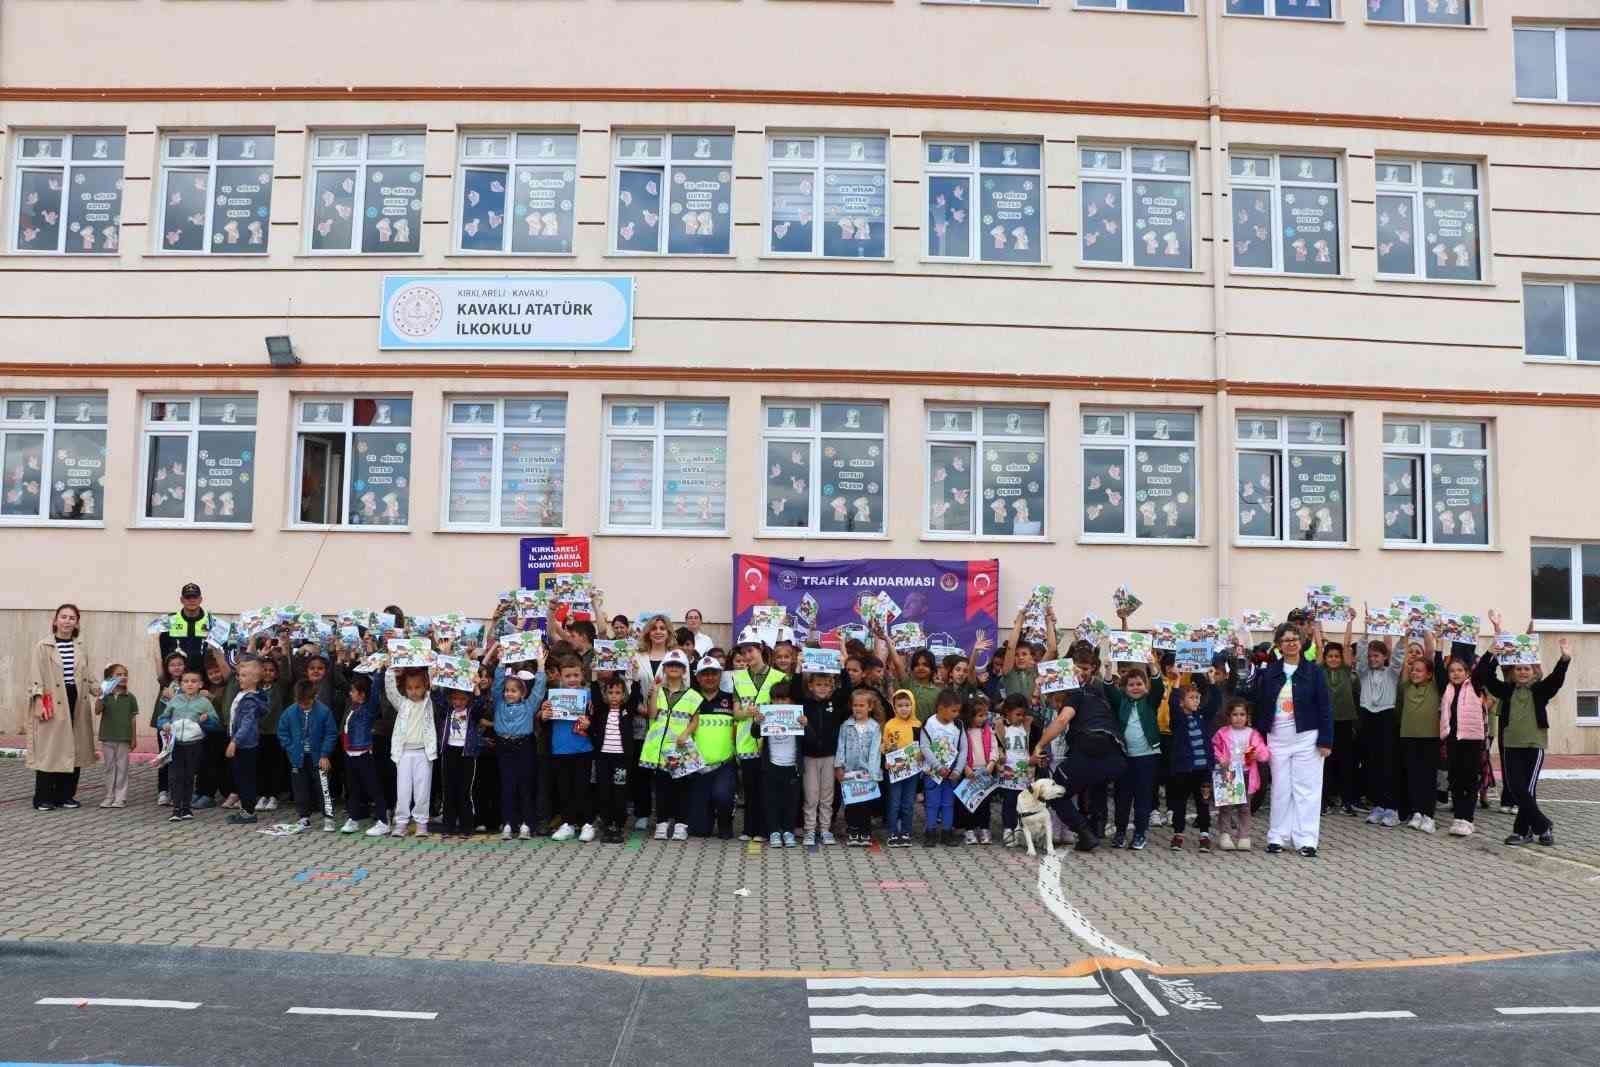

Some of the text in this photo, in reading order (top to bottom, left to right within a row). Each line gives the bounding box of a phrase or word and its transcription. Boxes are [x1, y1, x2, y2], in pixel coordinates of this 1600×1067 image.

[457, 300, 592, 315] KAVAKLI ATATÜRK
[456, 320, 532, 335] İLKOKULU
[802, 576, 935, 587] TRAFİK JANDARMASI
